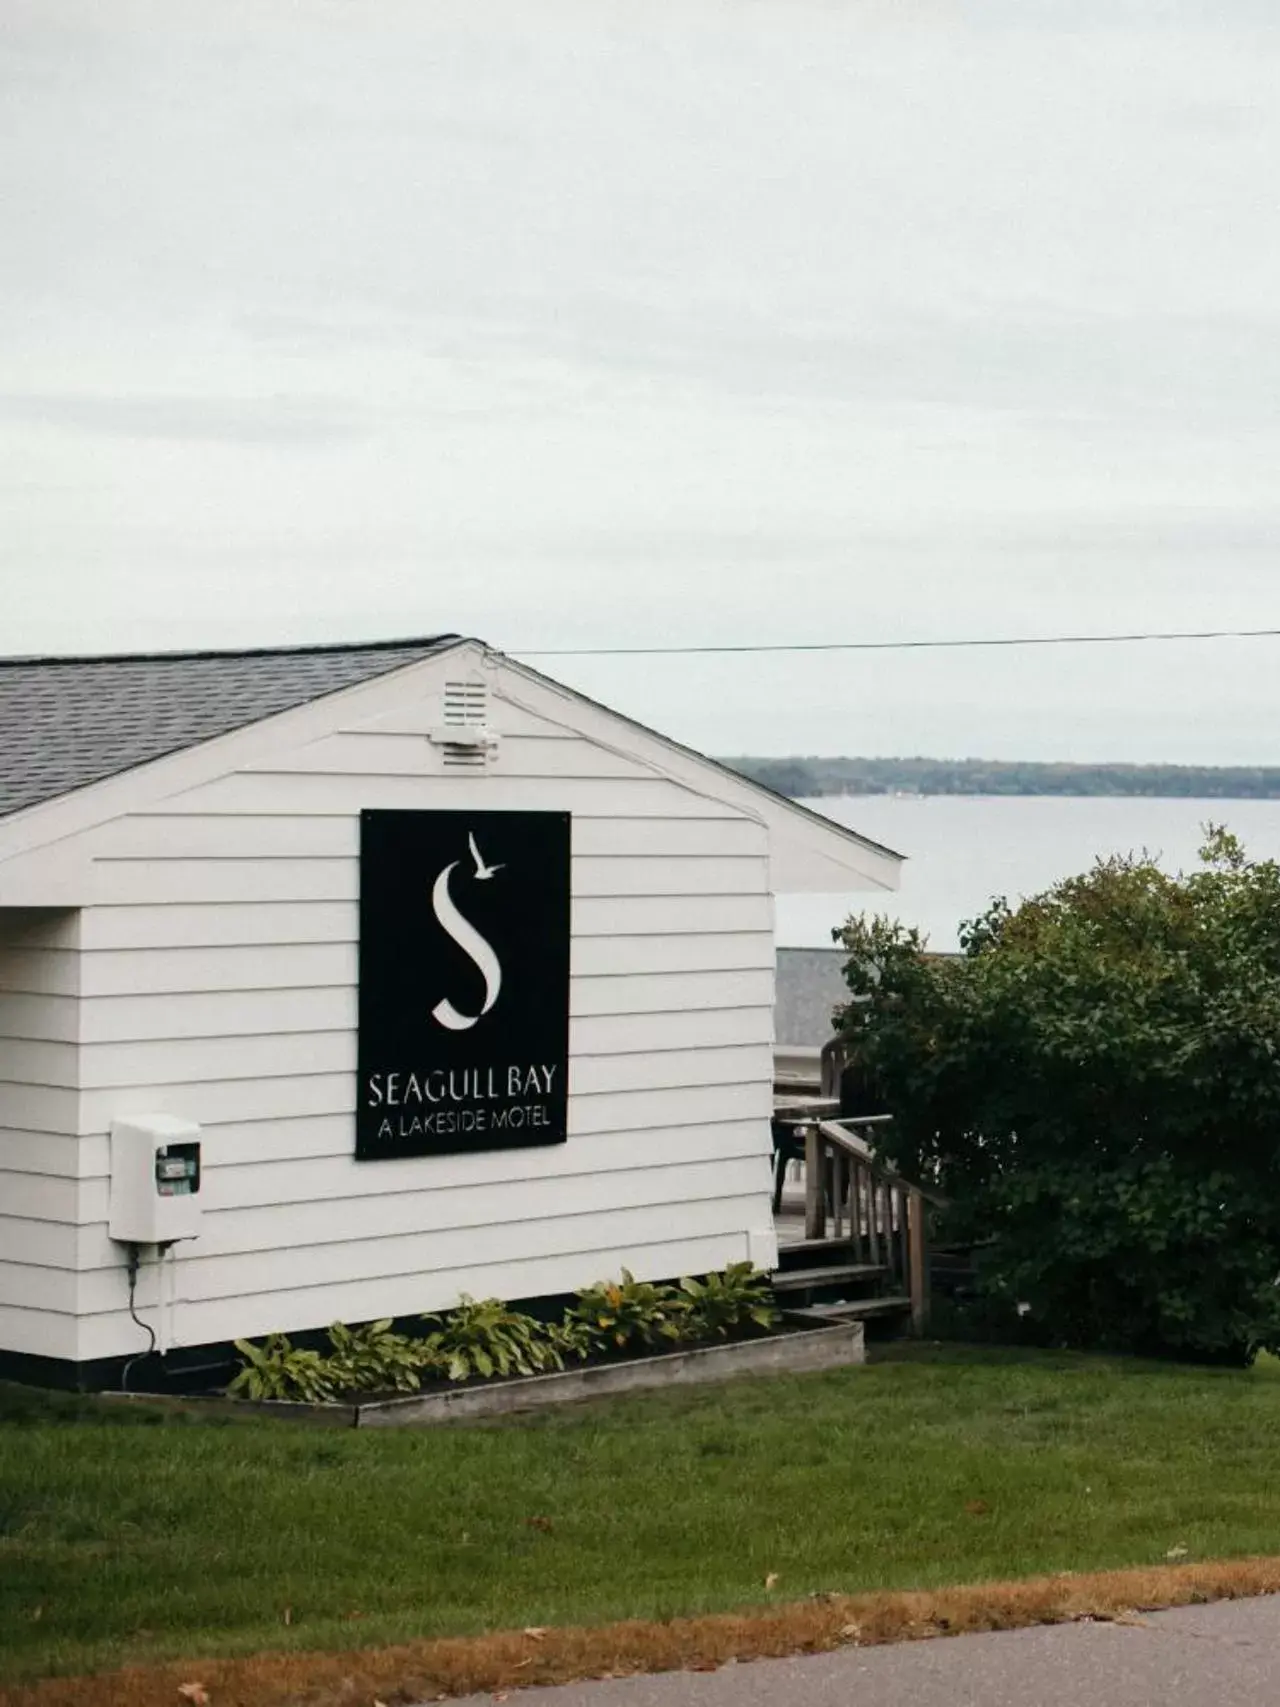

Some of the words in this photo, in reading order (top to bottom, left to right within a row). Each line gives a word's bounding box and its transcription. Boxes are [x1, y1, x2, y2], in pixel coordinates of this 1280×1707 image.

[431, 859, 502, 1031] S
[368, 1066, 499, 1107] SEAGULL
[506, 1064, 557, 1097] BAY
[378, 1118, 393, 1139] A
[400, 1108, 487, 1136] LAKESIDE
[490, 1105, 551, 1129] MOTEL
